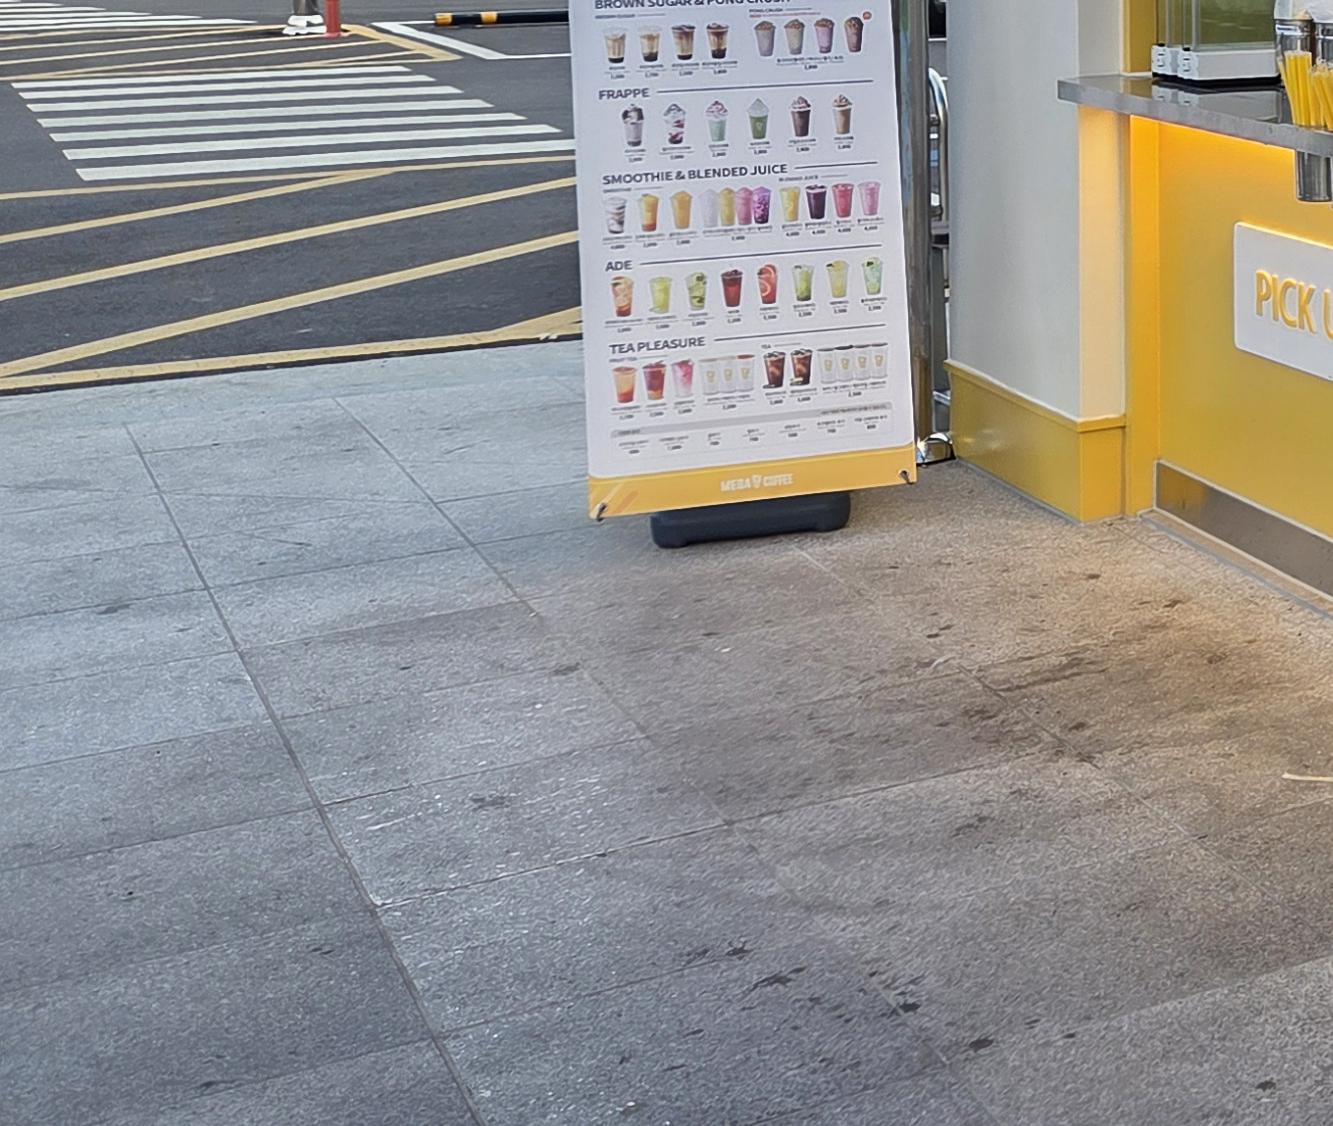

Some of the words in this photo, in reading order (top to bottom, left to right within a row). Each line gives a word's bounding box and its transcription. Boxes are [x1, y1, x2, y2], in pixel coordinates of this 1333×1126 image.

[598, 87, 650, 100] FRAPPE
[602, 173, 673, 185] SMOOTHIE
[675, 171, 687, 181] &
[687, 166, 748, 180] BLENDED
[750, 164, 788, 176] JUICE
[605, 260, 633, 272] ADE
[1255, 269, 1317, 335] PICK
[608, 344, 635, 355] TEA
[637, 337, 706, 351] PLEASURE
[720, 477, 752, 492] MEGA
[763, 473, 794, 487] COFFEE
